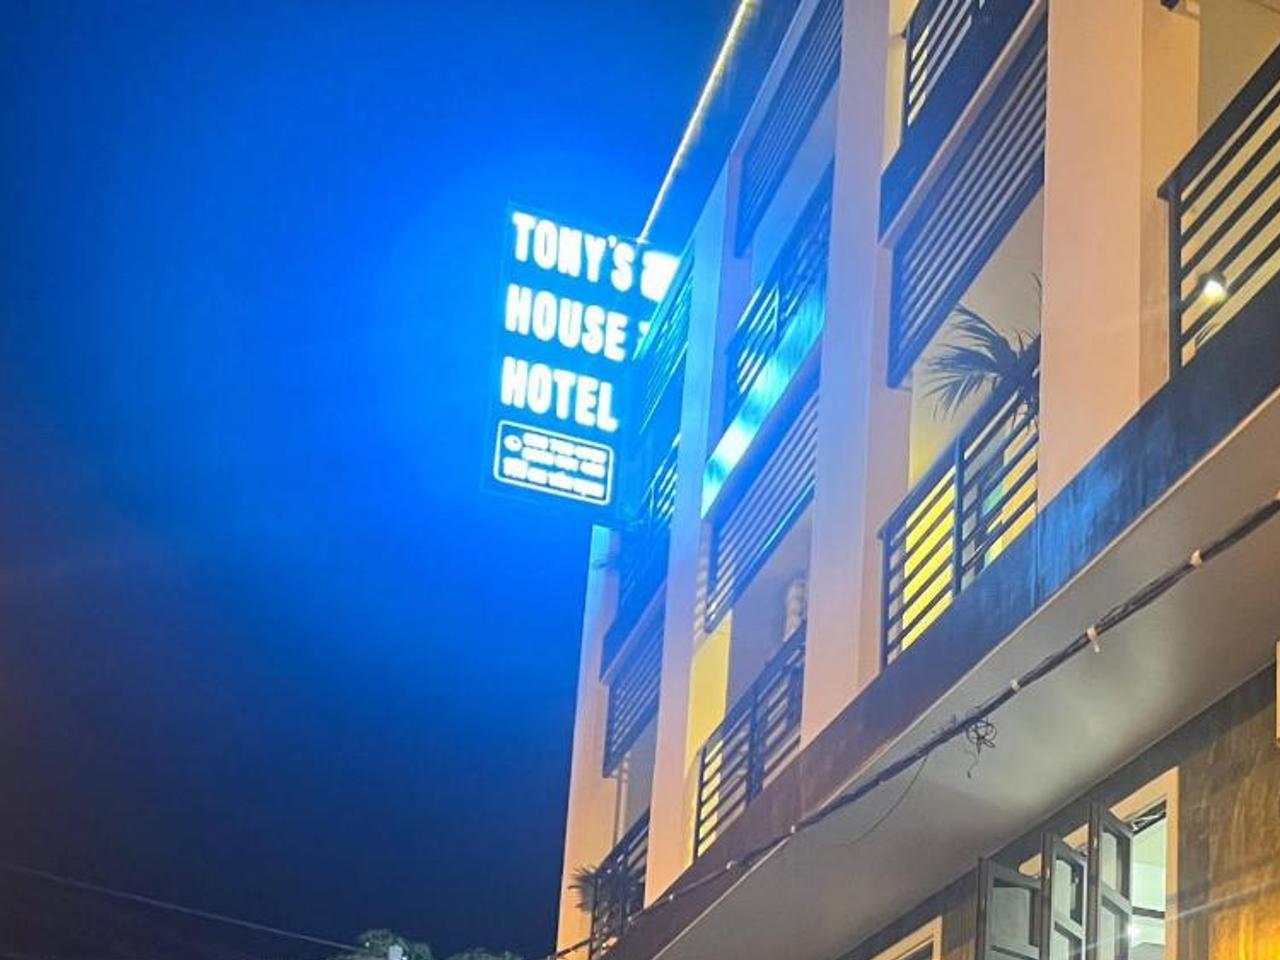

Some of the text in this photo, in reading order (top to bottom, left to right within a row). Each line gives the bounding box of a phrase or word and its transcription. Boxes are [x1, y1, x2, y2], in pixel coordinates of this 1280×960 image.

[512, 211, 635, 292] TONY'S
[505, 283, 628, 362] HOUSE
[501, 356, 619, 433] HOTEL
